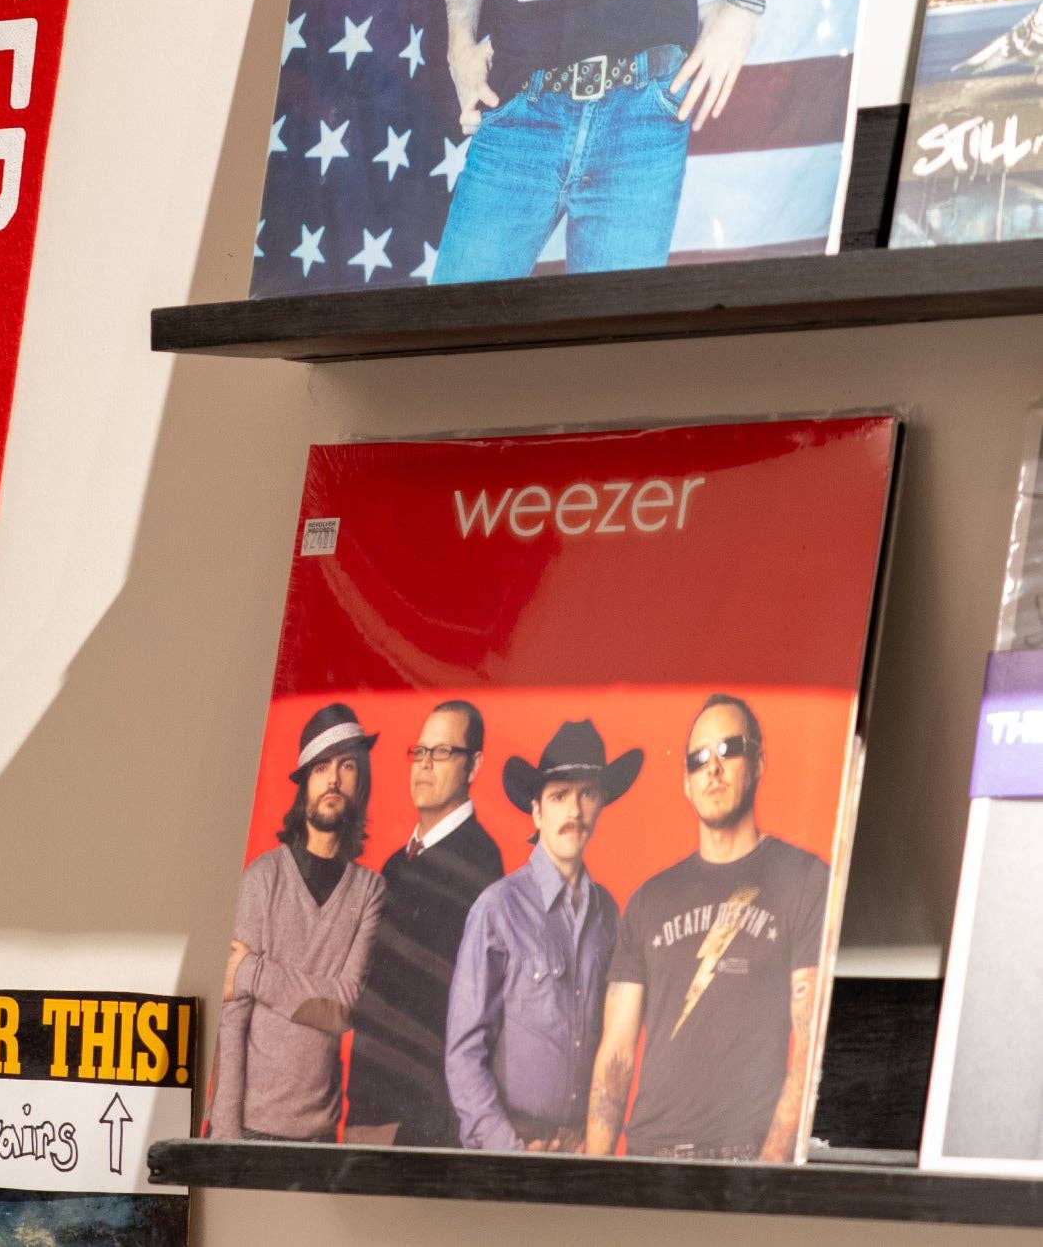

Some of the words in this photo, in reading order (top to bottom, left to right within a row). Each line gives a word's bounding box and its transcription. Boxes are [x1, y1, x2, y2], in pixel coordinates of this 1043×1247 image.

[454, 477, 705, 540] weezer
[663, 904, 713, 947] DEATH
[42, 997, 191, 1085] THIS!
